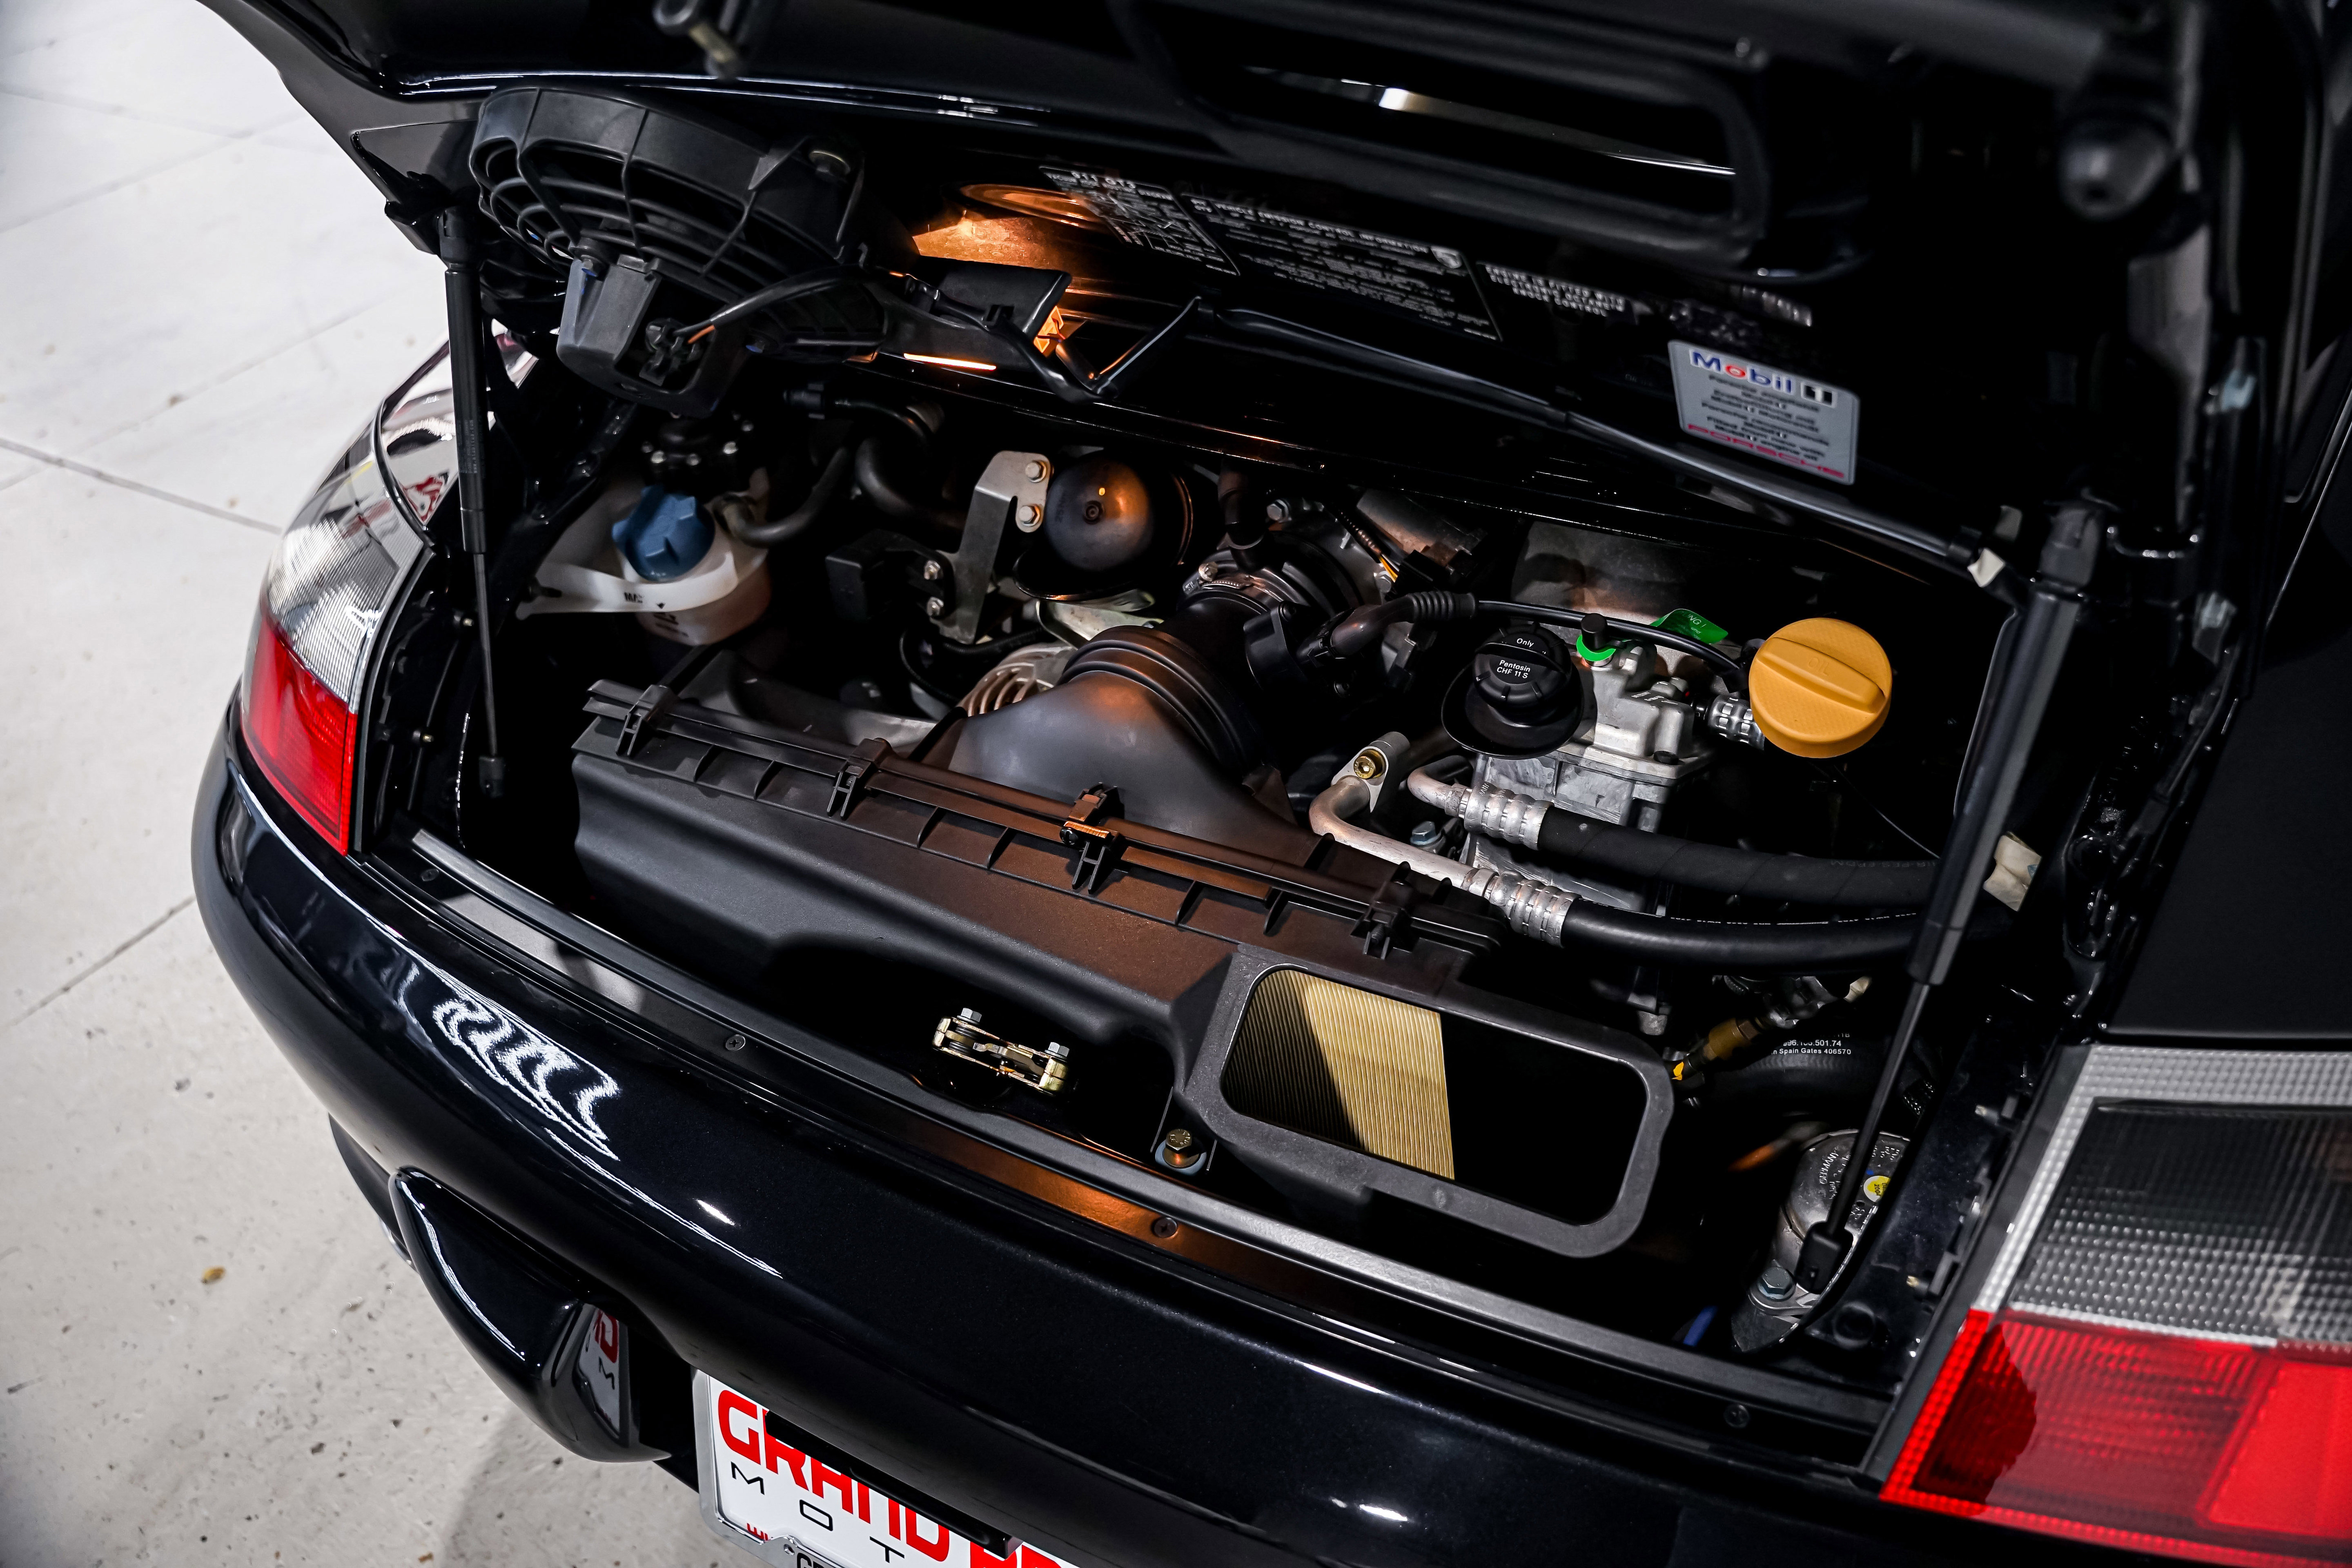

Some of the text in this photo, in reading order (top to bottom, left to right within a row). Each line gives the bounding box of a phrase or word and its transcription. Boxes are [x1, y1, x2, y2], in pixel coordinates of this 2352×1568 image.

[1215, 203, 1255, 216] VEHICLE
[1257, 209, 1305, 226] EMISSION
[1307, 221, 1356, 238] CONTROL
[1692, 352, 1792, 394] Mobil
[1688, 424, 1844, 478] PORSCHE
[1517, 638, 1534, 647] Only
[1499, 659, 1530, 672] Pentosin
[1808, 657, 1829, 676] OIL
